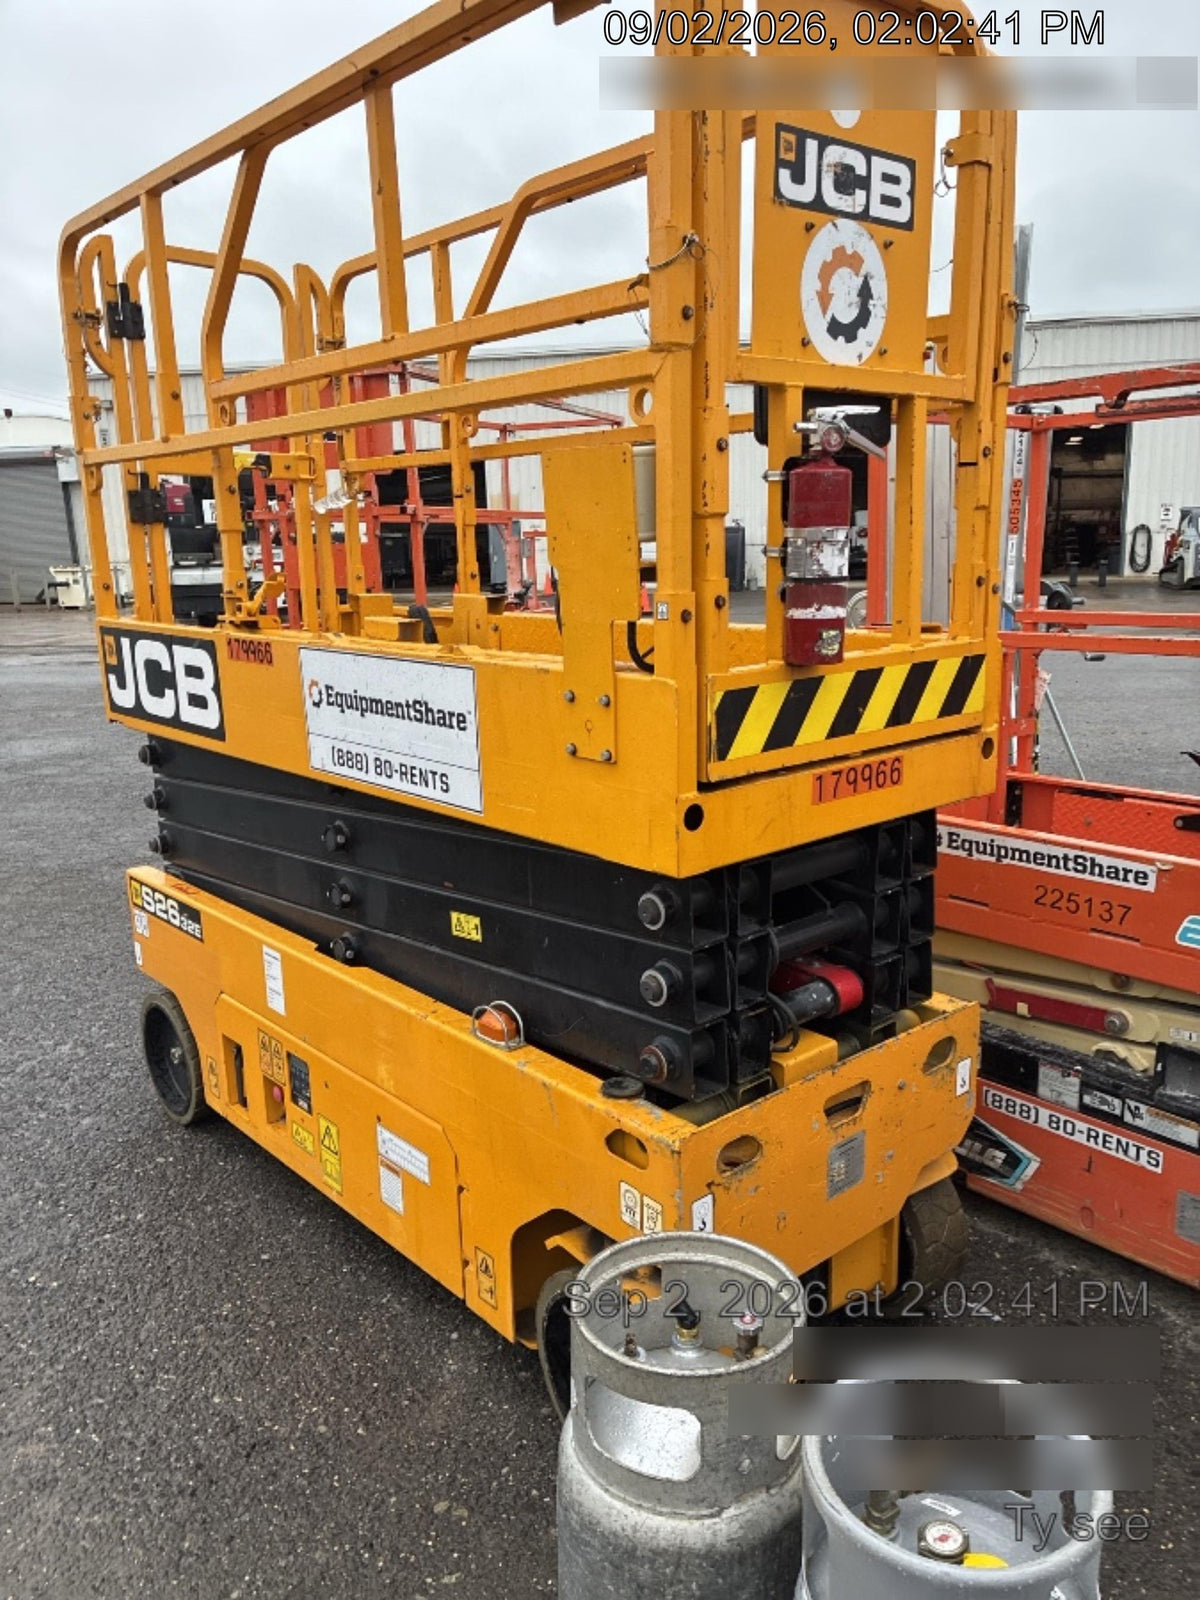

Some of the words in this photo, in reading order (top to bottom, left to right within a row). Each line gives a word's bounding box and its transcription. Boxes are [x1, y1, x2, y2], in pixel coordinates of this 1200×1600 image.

[778, 137, 912, 223] JCB
[227, 636, 274, 665] 179966
[108, 636, 221, 730] JCB
[324, 684, 468, 732] EquipmentShare
[331, 745, 369, 775] (888)
[373, 757, 450, 793] 80-RENTS
[814, 756, 902, 803] 179966
[946, 832, 1150, 887] EquipmentShare
[1034, 885, 1132, 926] 225137
[984, 1086, 1039, 1124] (888)
[1047, 1113, 1162, 1169] 80-RENTS
